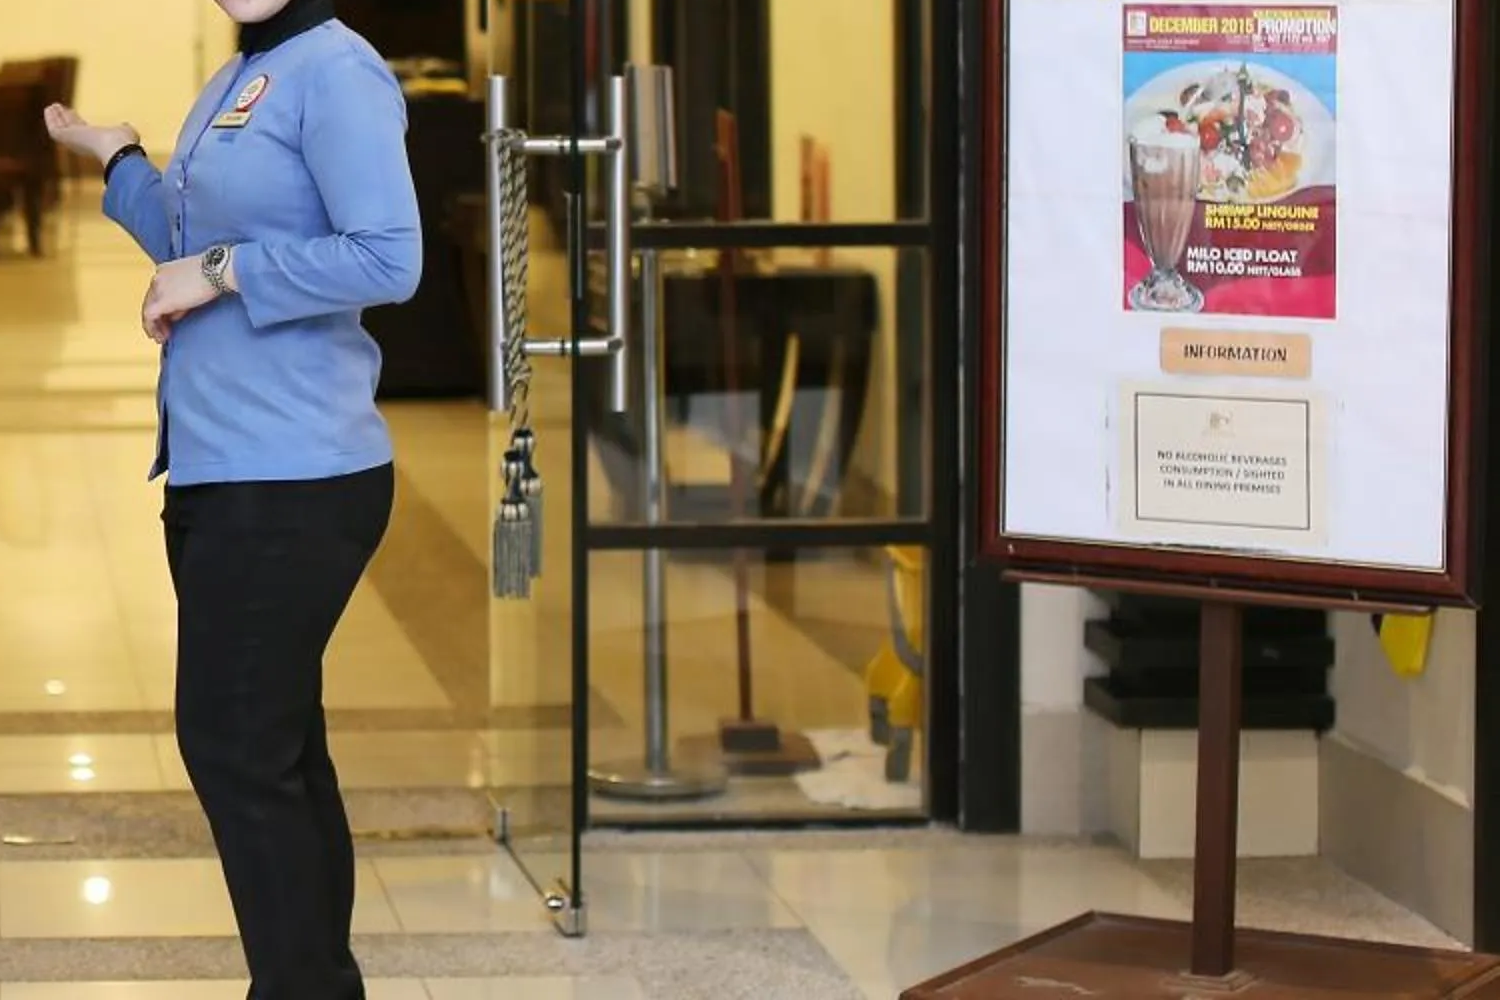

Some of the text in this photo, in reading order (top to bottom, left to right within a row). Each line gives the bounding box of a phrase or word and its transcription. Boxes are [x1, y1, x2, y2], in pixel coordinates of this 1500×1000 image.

[1149, 15, 1218, 34] DECEMBER
[1221, 16, 1255, 34] 2015
[1205, 203, 1320, 219] SHRIMP LINGUINE
[1187, 247, 1299, 263] MILO ICED FLOAT
[1187, 260, 1244, 275] RM10.00
[1183, 343, 1288, 362] INFORMATION
[1157, 450, 1173, 460] NO
[1159, 464, 1234, 478] CONSUMPTION
[1163, 478, 1175, 488] IN
